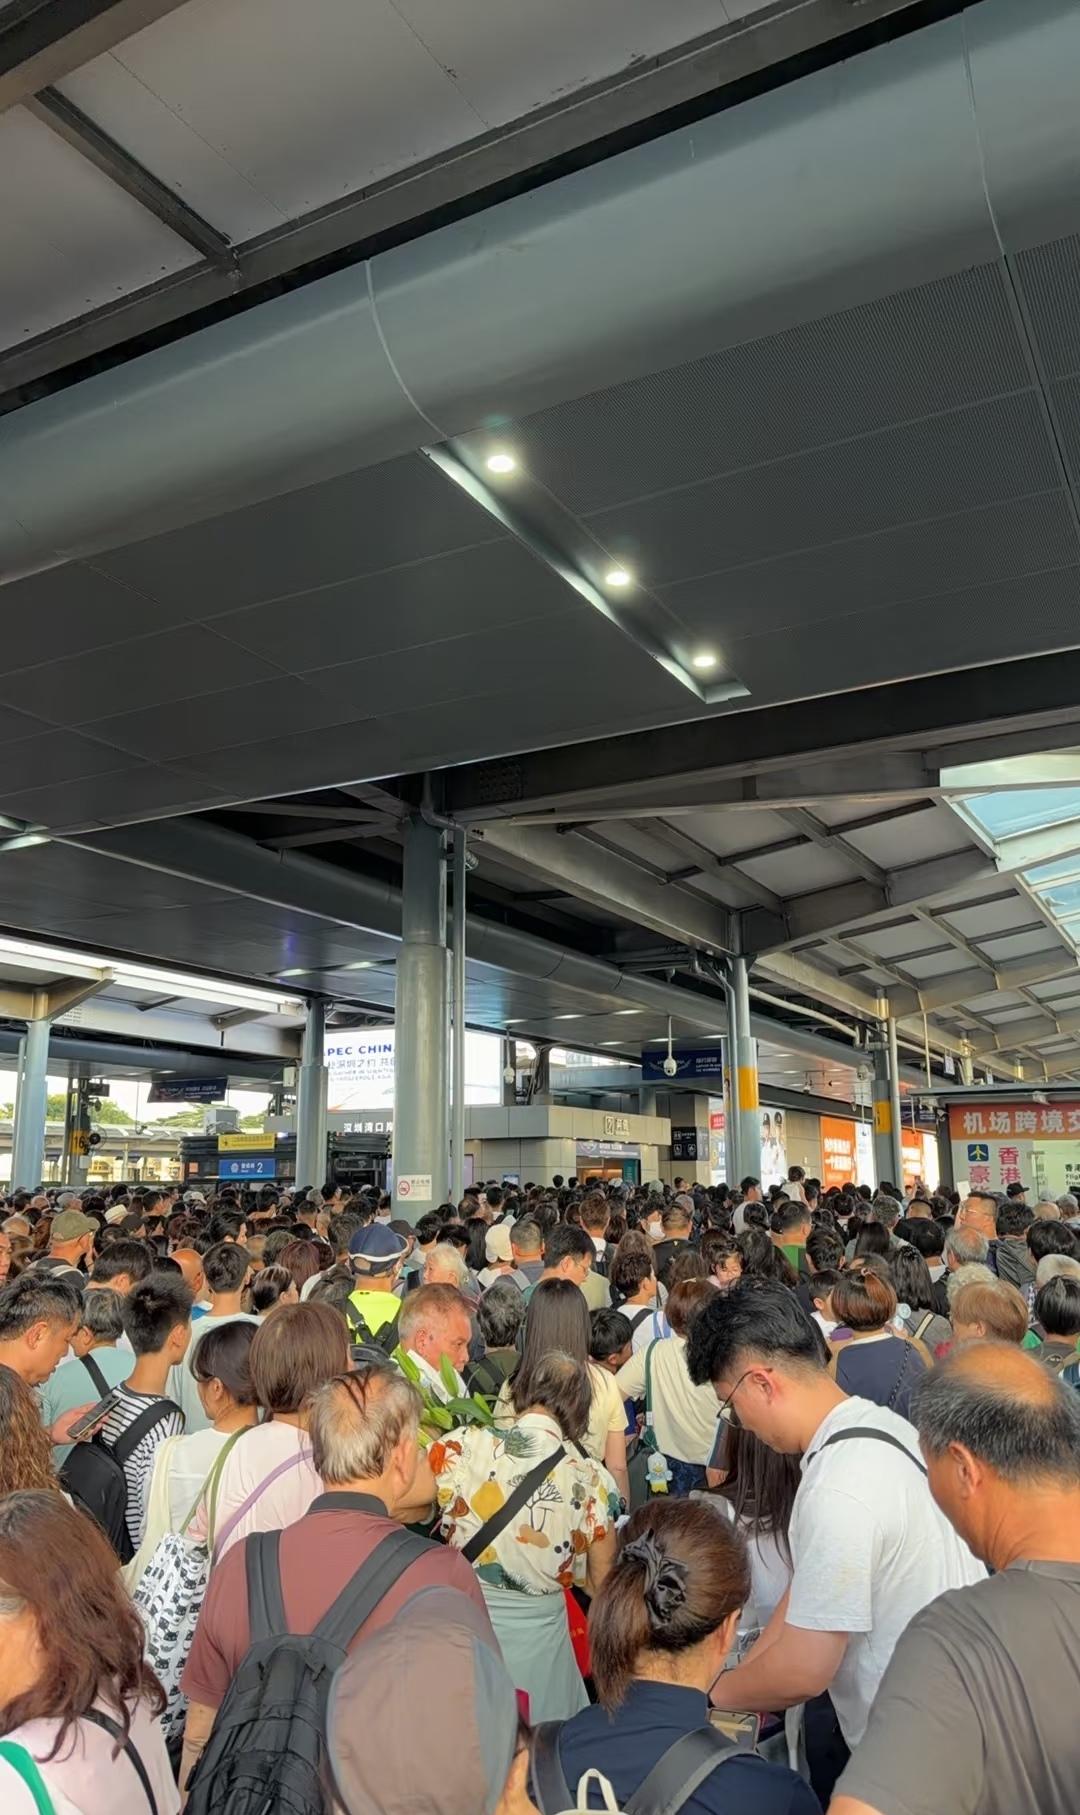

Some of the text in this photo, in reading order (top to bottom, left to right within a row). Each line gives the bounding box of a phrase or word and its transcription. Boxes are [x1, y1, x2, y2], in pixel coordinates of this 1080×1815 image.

[323, 1044, 394, 1056] PEC CHIN
[256, 1162, 263, 1173] 2
[998, 1147, 1021, 1185] 香港
